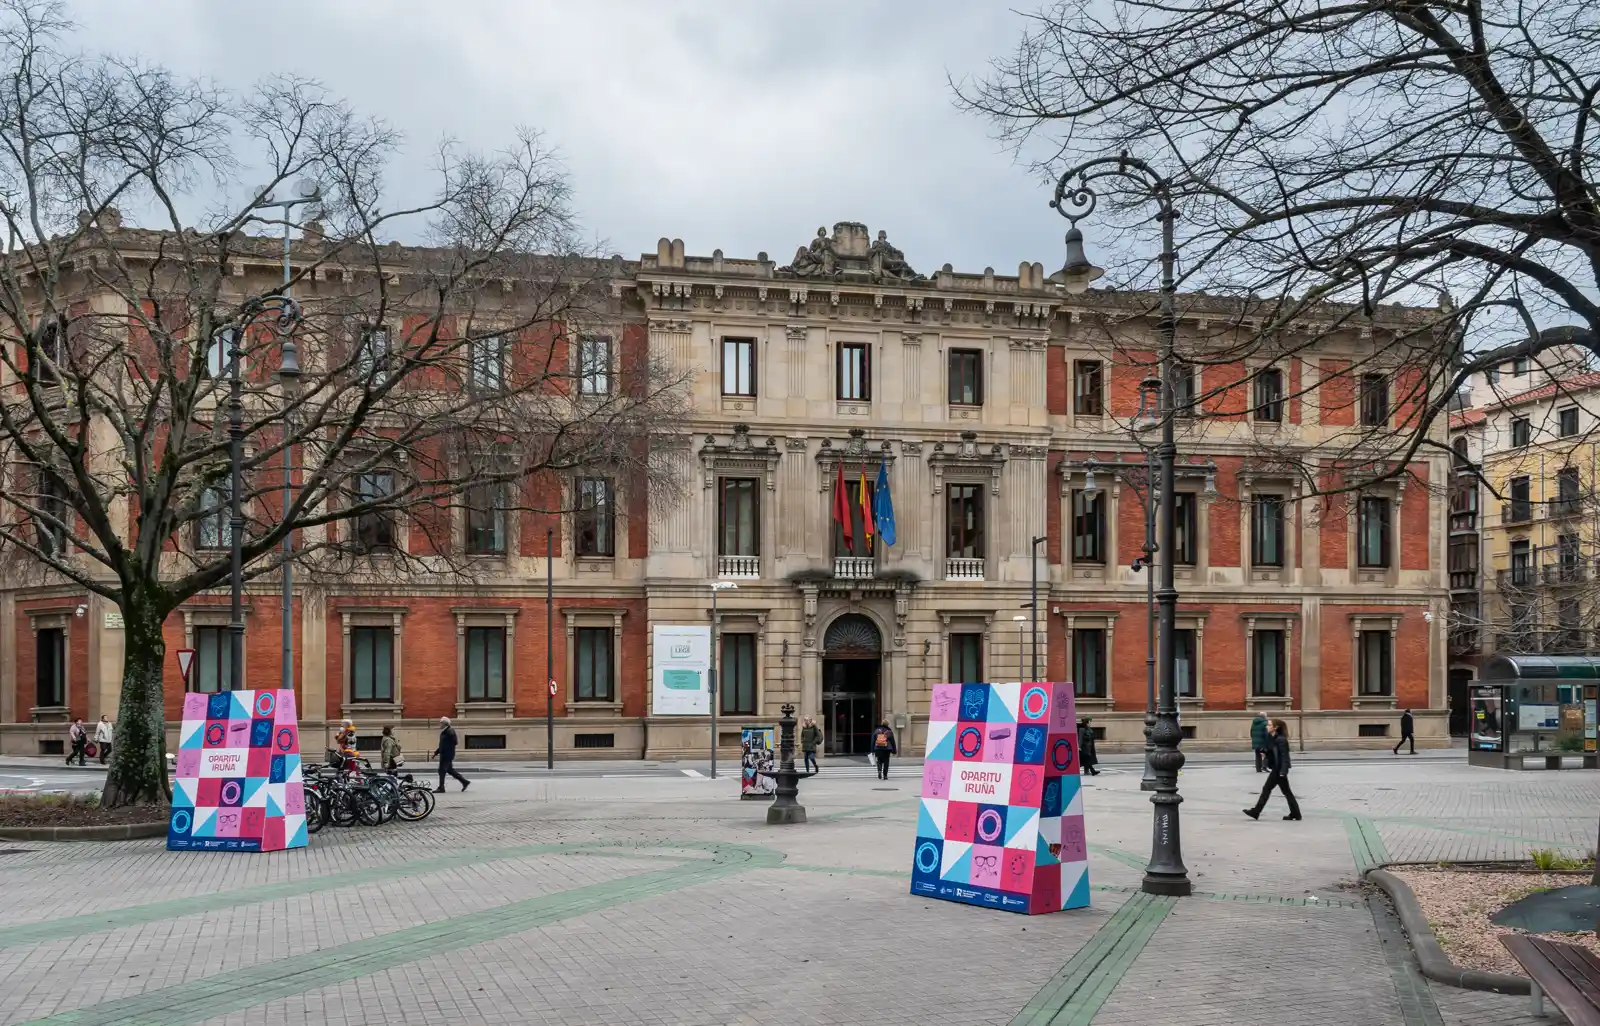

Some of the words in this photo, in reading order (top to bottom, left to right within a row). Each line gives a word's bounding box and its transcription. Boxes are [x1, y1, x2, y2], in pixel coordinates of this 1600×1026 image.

[208, 754, 241, 763] OPARITU
[960, 770, 1002, 783] OPARITU
[964, 782, 995, 795] IRUÑA
